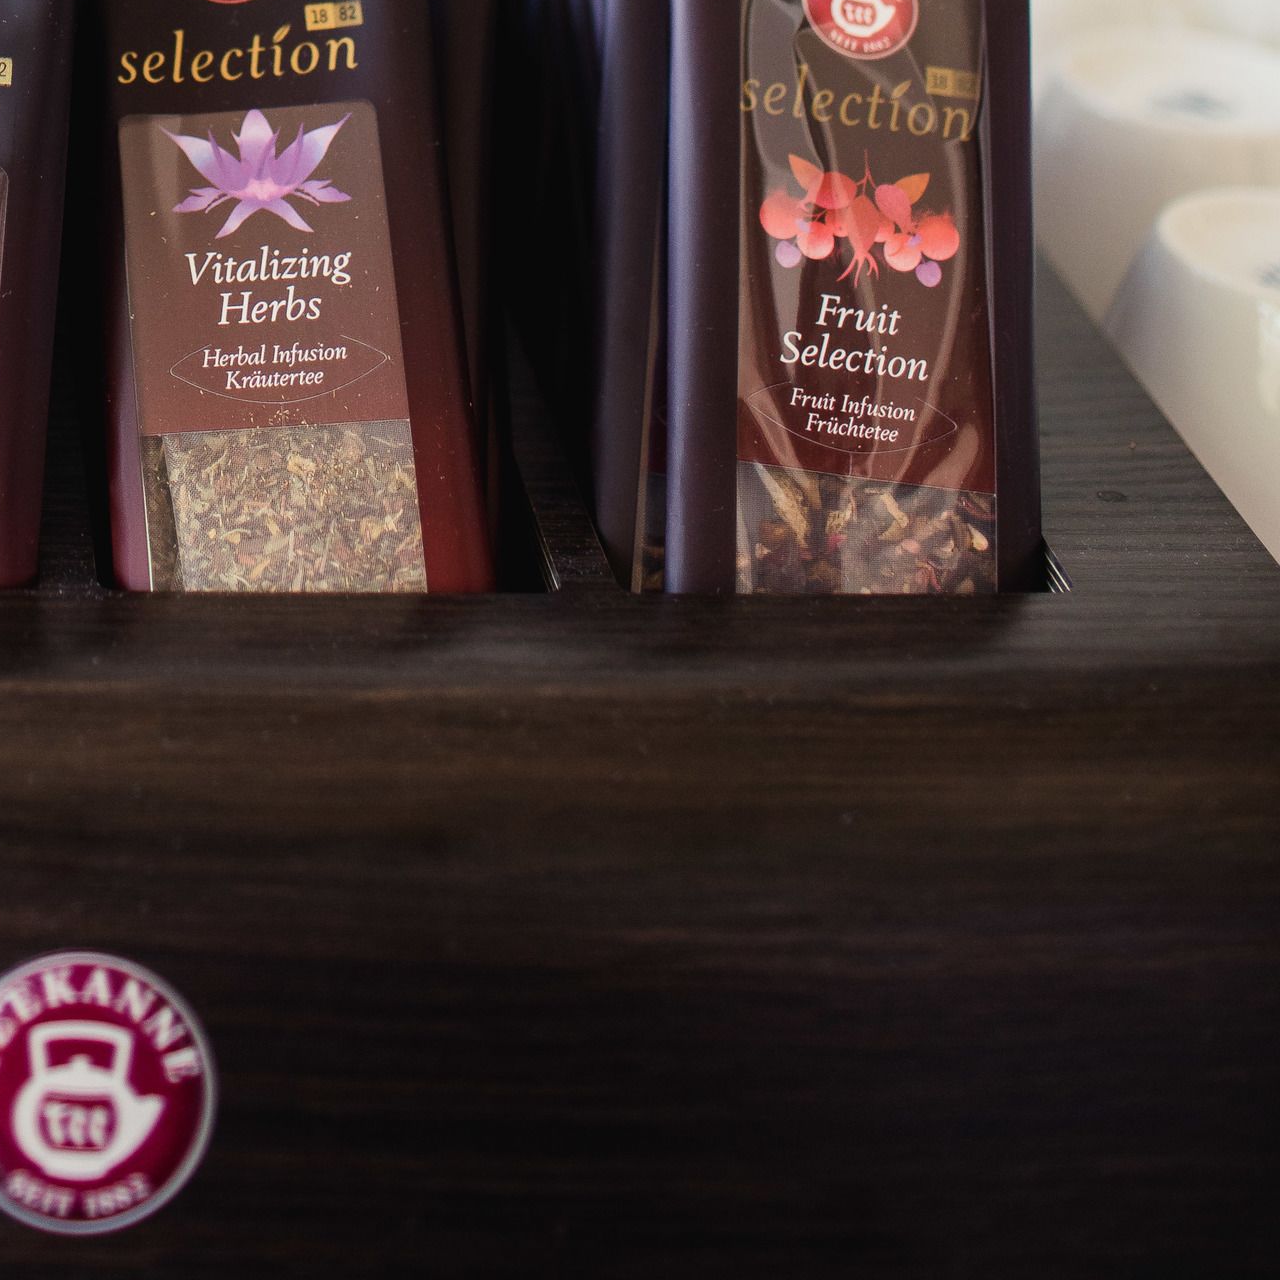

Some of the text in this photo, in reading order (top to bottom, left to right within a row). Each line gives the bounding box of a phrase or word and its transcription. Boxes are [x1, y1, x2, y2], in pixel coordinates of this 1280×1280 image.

[118, 24, 359, 84] selection
[739, 63, 969, 141] selection
[184, 245, 352, 285] Vitalizing
[218, 286, 322, 325] Herbs
[816, 293, 901, 335] Fruit
[202, 342, 347, 368] Herbal Infusion
[780, 331, 928, 381] Selection
[226, 370, 324, 389] Kräutertee
[790, 387, 915, 421] Fruit Infusion
[805, 412, 899, 442] Früchtetee
